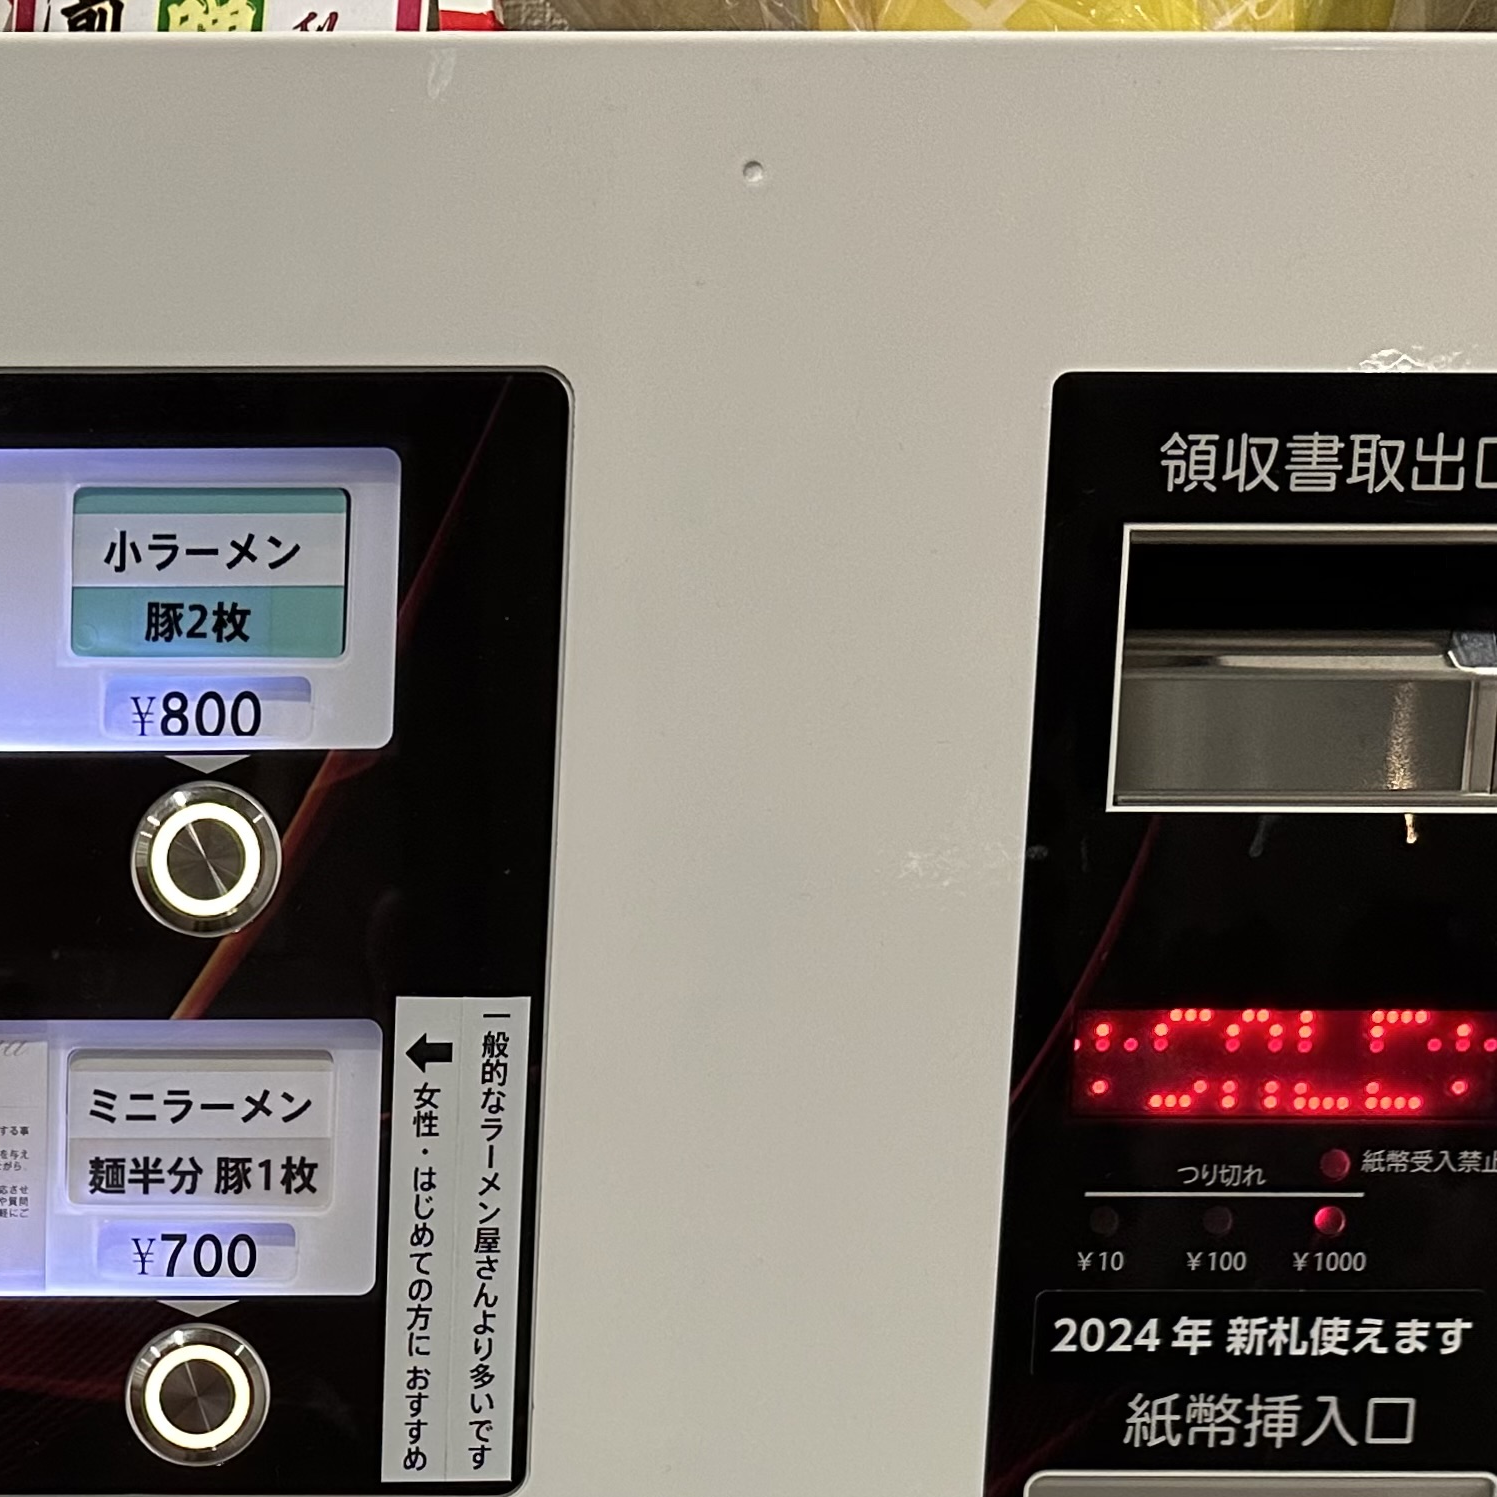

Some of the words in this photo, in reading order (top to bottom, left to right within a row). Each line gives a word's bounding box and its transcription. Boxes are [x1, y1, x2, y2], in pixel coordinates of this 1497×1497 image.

[104, 531, 301, 573] 小ラーメン
[144, 602, 251, 644] 豚2枚
[131, 691, 262, 738] ¥800
[89, 1089, 312, 1124] ミニラーメン
[215, 1156, 319, 1195] 豚1枚
[1177, 1164, 1267, 1186] つり切れ
[131, 1233, 257, 1278] ¥700
[468, 1012, 512, 1470] 一般的なラーメン屋さんより多いです
[1123, 1392, 1417, 1449] 紙幣挿入口
